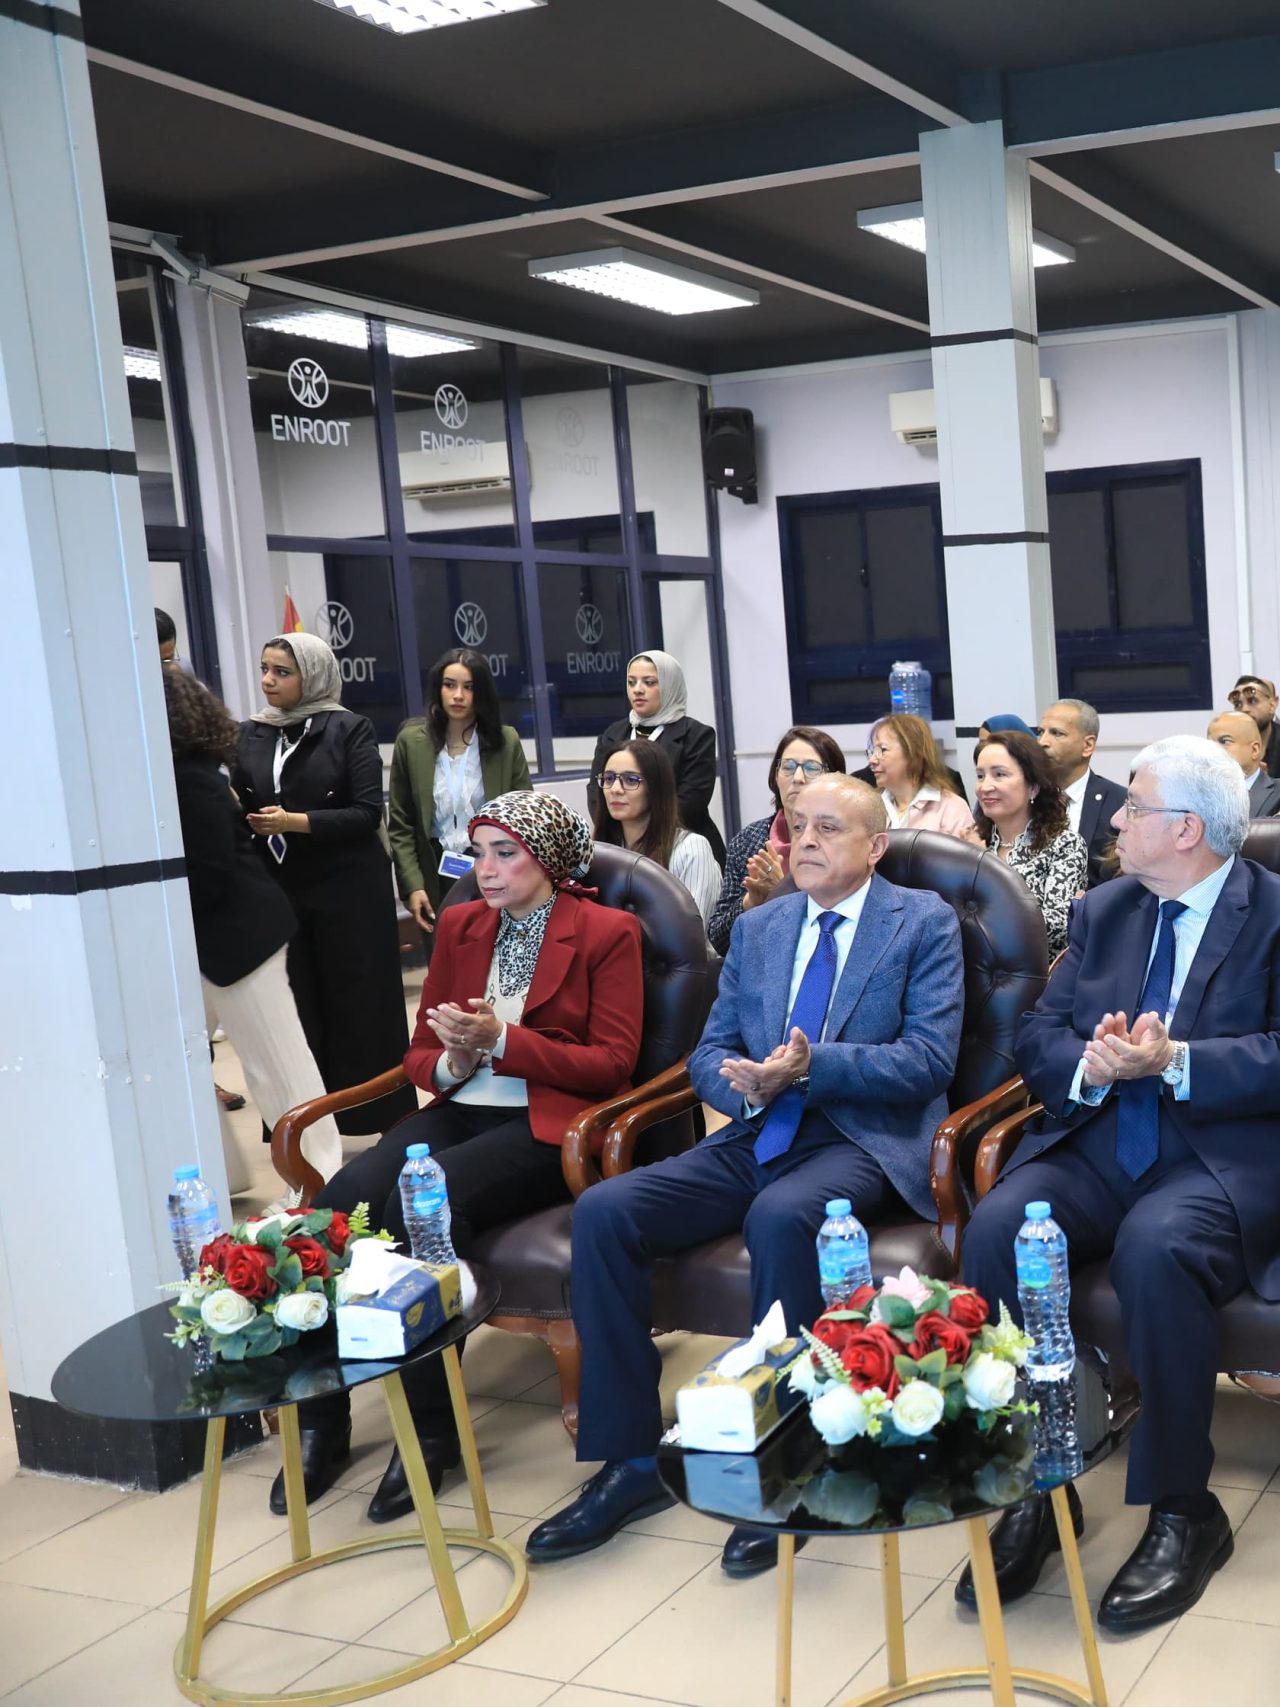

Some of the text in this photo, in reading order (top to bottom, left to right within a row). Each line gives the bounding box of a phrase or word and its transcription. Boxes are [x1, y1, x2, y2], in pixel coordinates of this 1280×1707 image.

[270, 414, 351, 447] ENROOT
[340, 657, 377, 682] OOT
[566, 651, 621, 674] ENROOT
